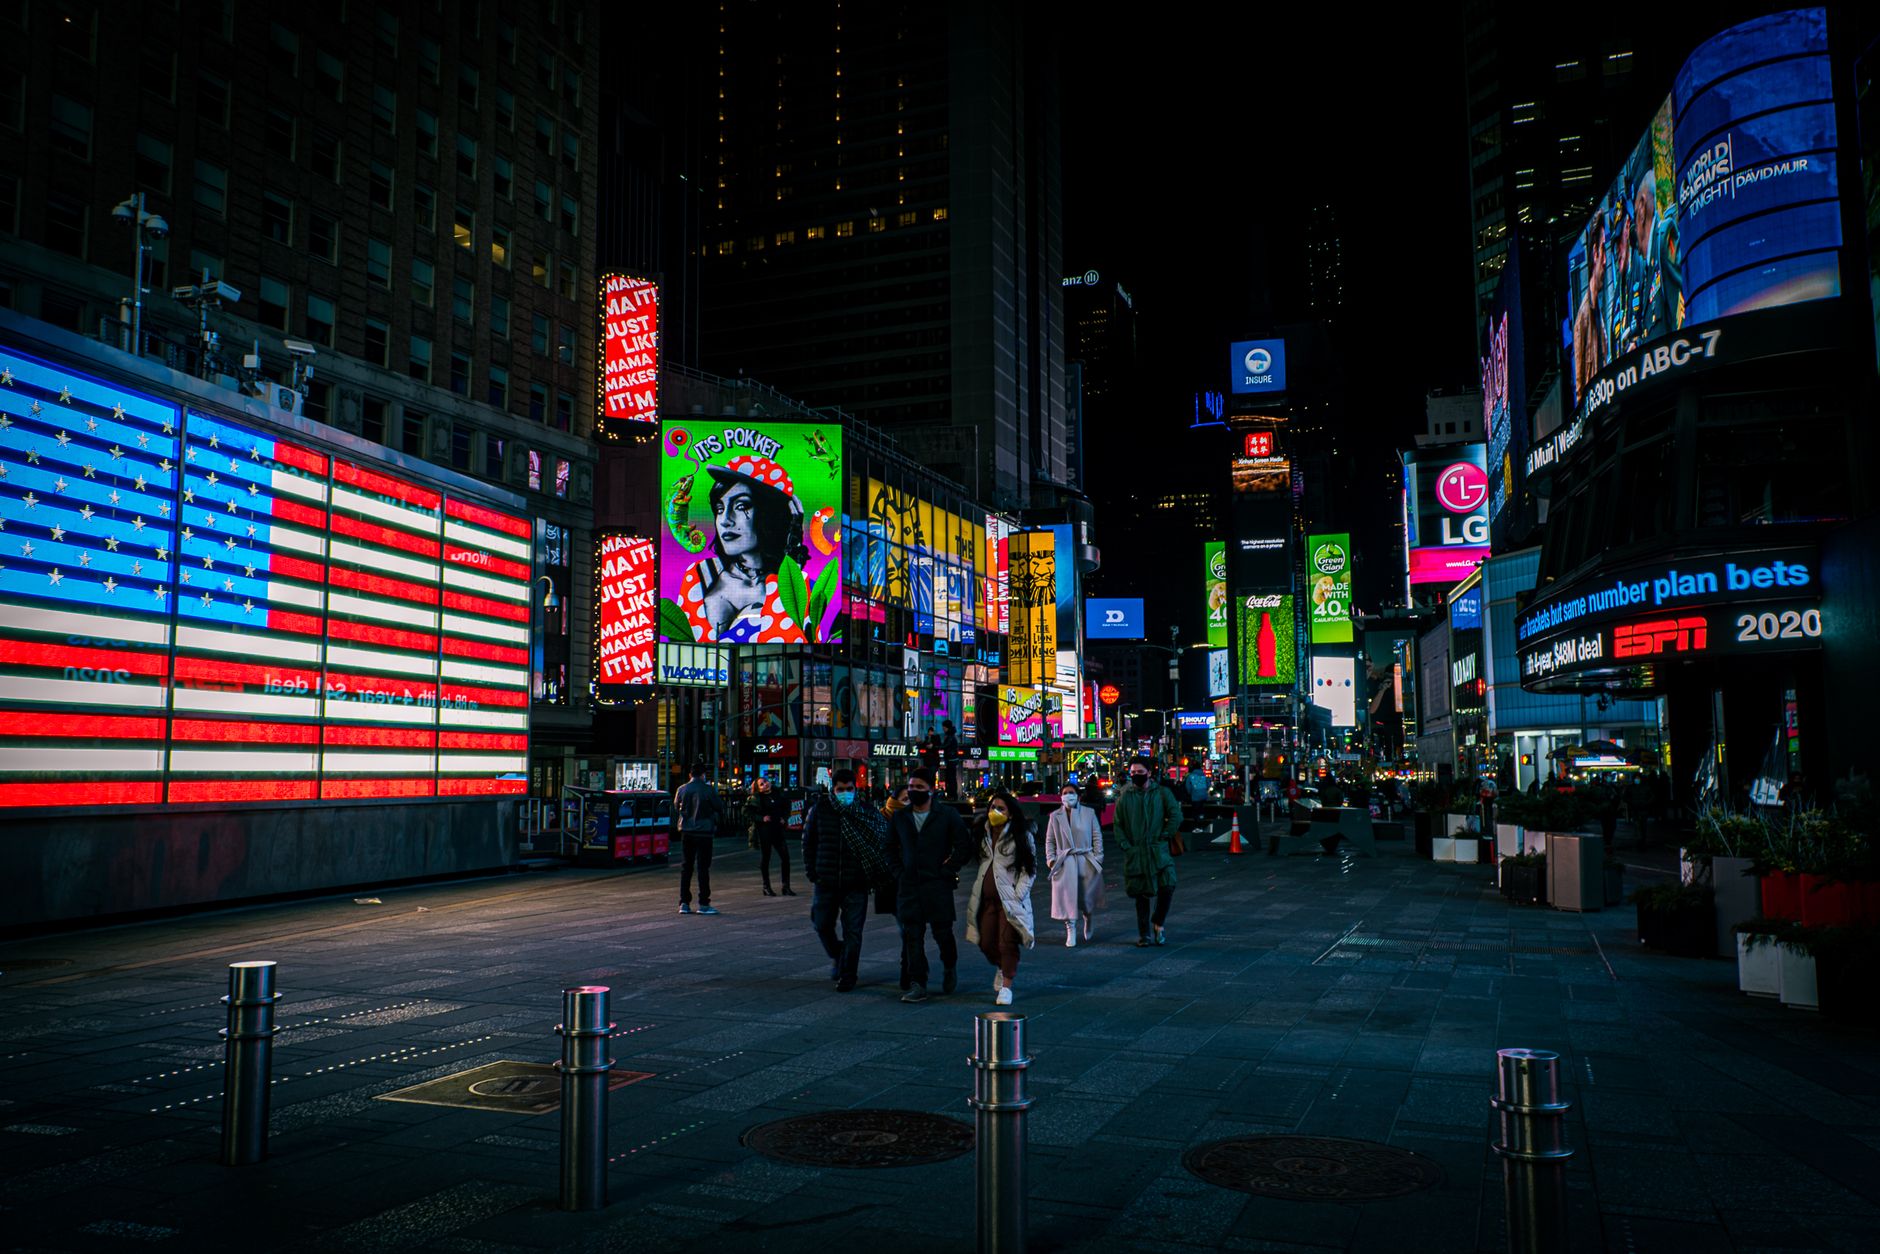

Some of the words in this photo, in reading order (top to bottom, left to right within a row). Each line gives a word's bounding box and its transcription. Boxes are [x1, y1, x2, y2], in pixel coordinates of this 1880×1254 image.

[1687, 141, 1728, 185] WORLD
[1736, 166, 1772, 188] DAVID
[1773, 159, 1808, 177] MUIR
[1688, 159, 1730, 200] NEWS
[1689, 177, 1731, 220] TONIGHT
[633, 287, 657, 307] IT!
[605, 315, 649, 339] JUST
[605, 353, 653, 374] MAMA
[1640, 329, 1722, 380] ABC-7
[605, 368, 656, 392] MAKES
[1245, 374, 1272, 385] INSURE
[1589, 378, 1614, 413] 6:30p
[1617, 365, 1638, 391] on
[608, 392, 634, 412] IT!
[693, 434, 724, 462] IT'S
[722, 427, 783, 461] POKKET
[1534, 442, 1555, 470] Muir
[1442, 516, 1488, 545] LG
[630, 543, 655, 566] IT!
[1318, 557, 1344, 565] Green
[1321, 563, 1344, 571] Giant
[601, 574, 647, 603] JUST
[1323, 583, 1349, 591] MADE
[1324, 591, 1349, 599] WITH
[1526, 608, 1550, 637] brackets
[1550, 604, 1563, 627] but
[1563, 599, 1587, 621] same
[1588, 580, 1648, 613] number
[1653, 570, 1718, 606] plan
[1725, 560, 1810, 591] bets
[1314, 600, 1349, 617] 40%
[600, 613, 651, 640] MAMA
[1035, 624, 1049, 632] TE
[1613, 616, 1708, 658] ESPN
[1737, 609, 1823, 642] 2020
[600, 628, 654, 658] MAKES
[1535, 651, 1555, 677] 4-year,
[1554, 643, 1578, 670] $48M
[1578, 633, 1603, 661] deal
[604, 655, 631, 677] IT!
